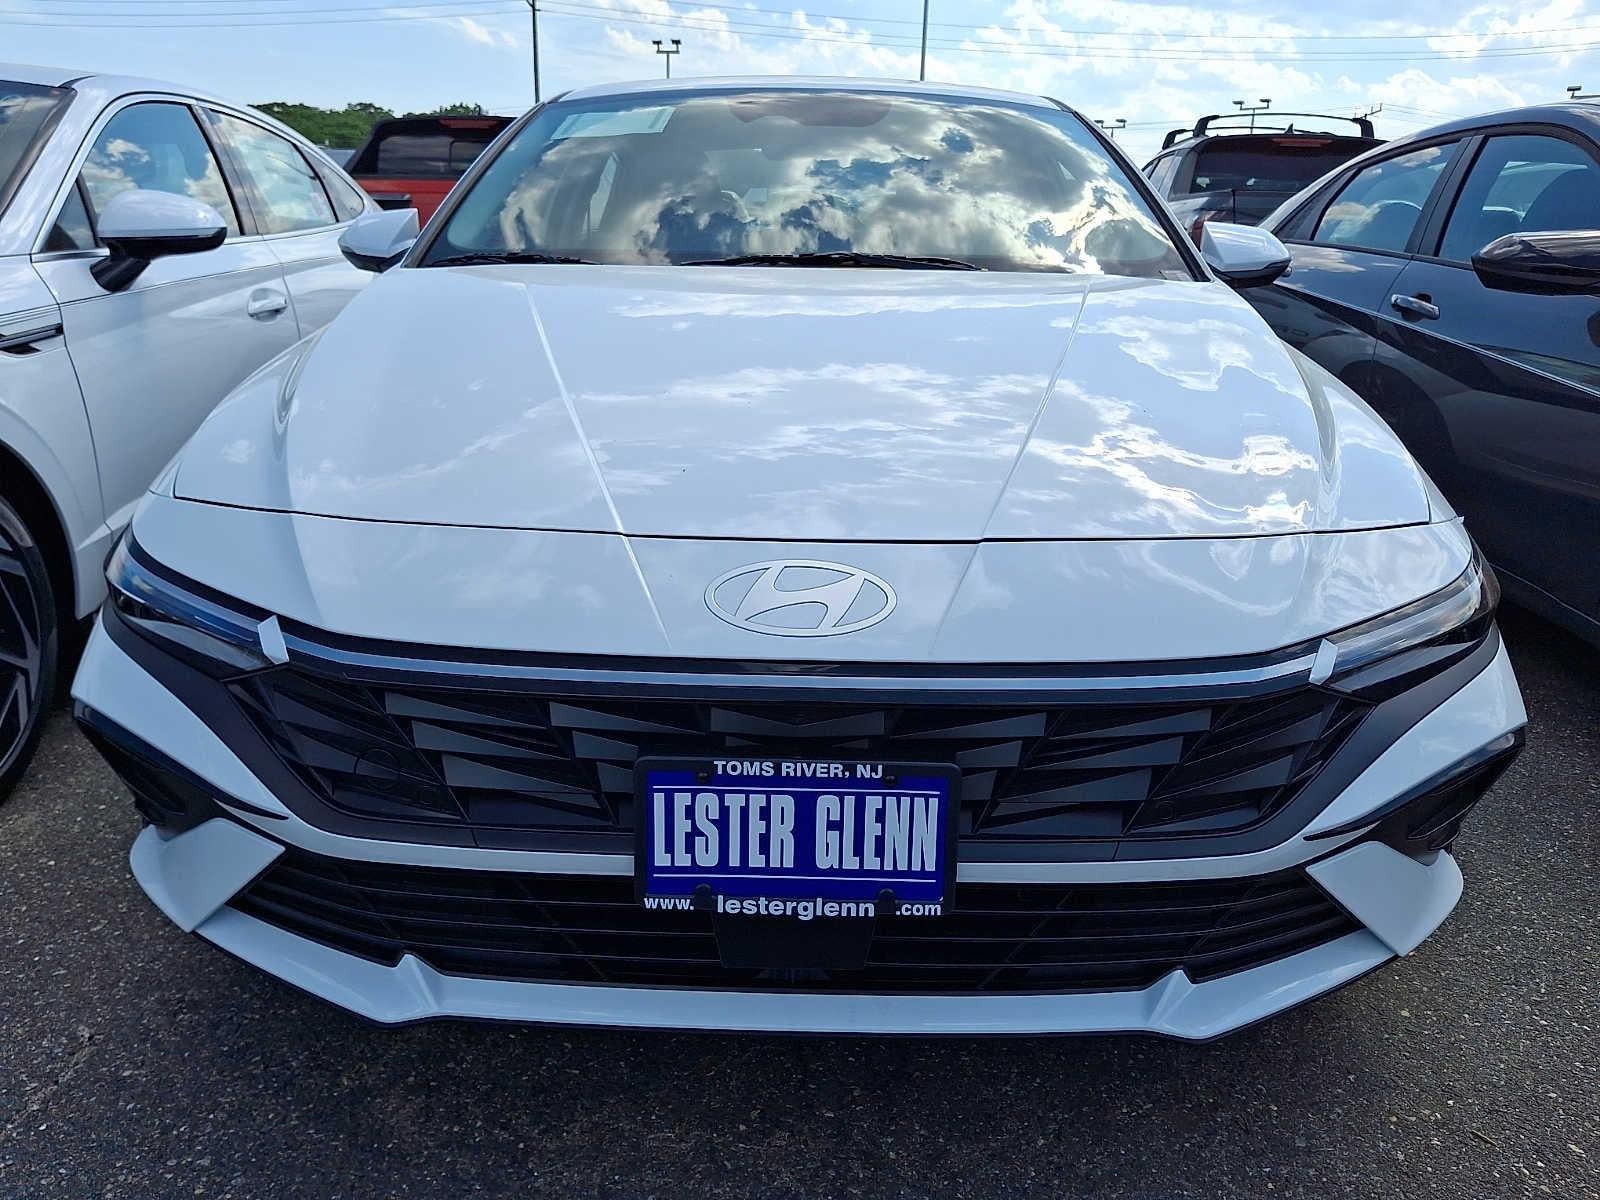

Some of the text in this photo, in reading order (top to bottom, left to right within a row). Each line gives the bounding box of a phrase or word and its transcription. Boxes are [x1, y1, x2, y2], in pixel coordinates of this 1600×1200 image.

[713, 760, 883, 779] TOMS RIVER, NJ
[653, 792, 939, 872] LESTER GLENN
